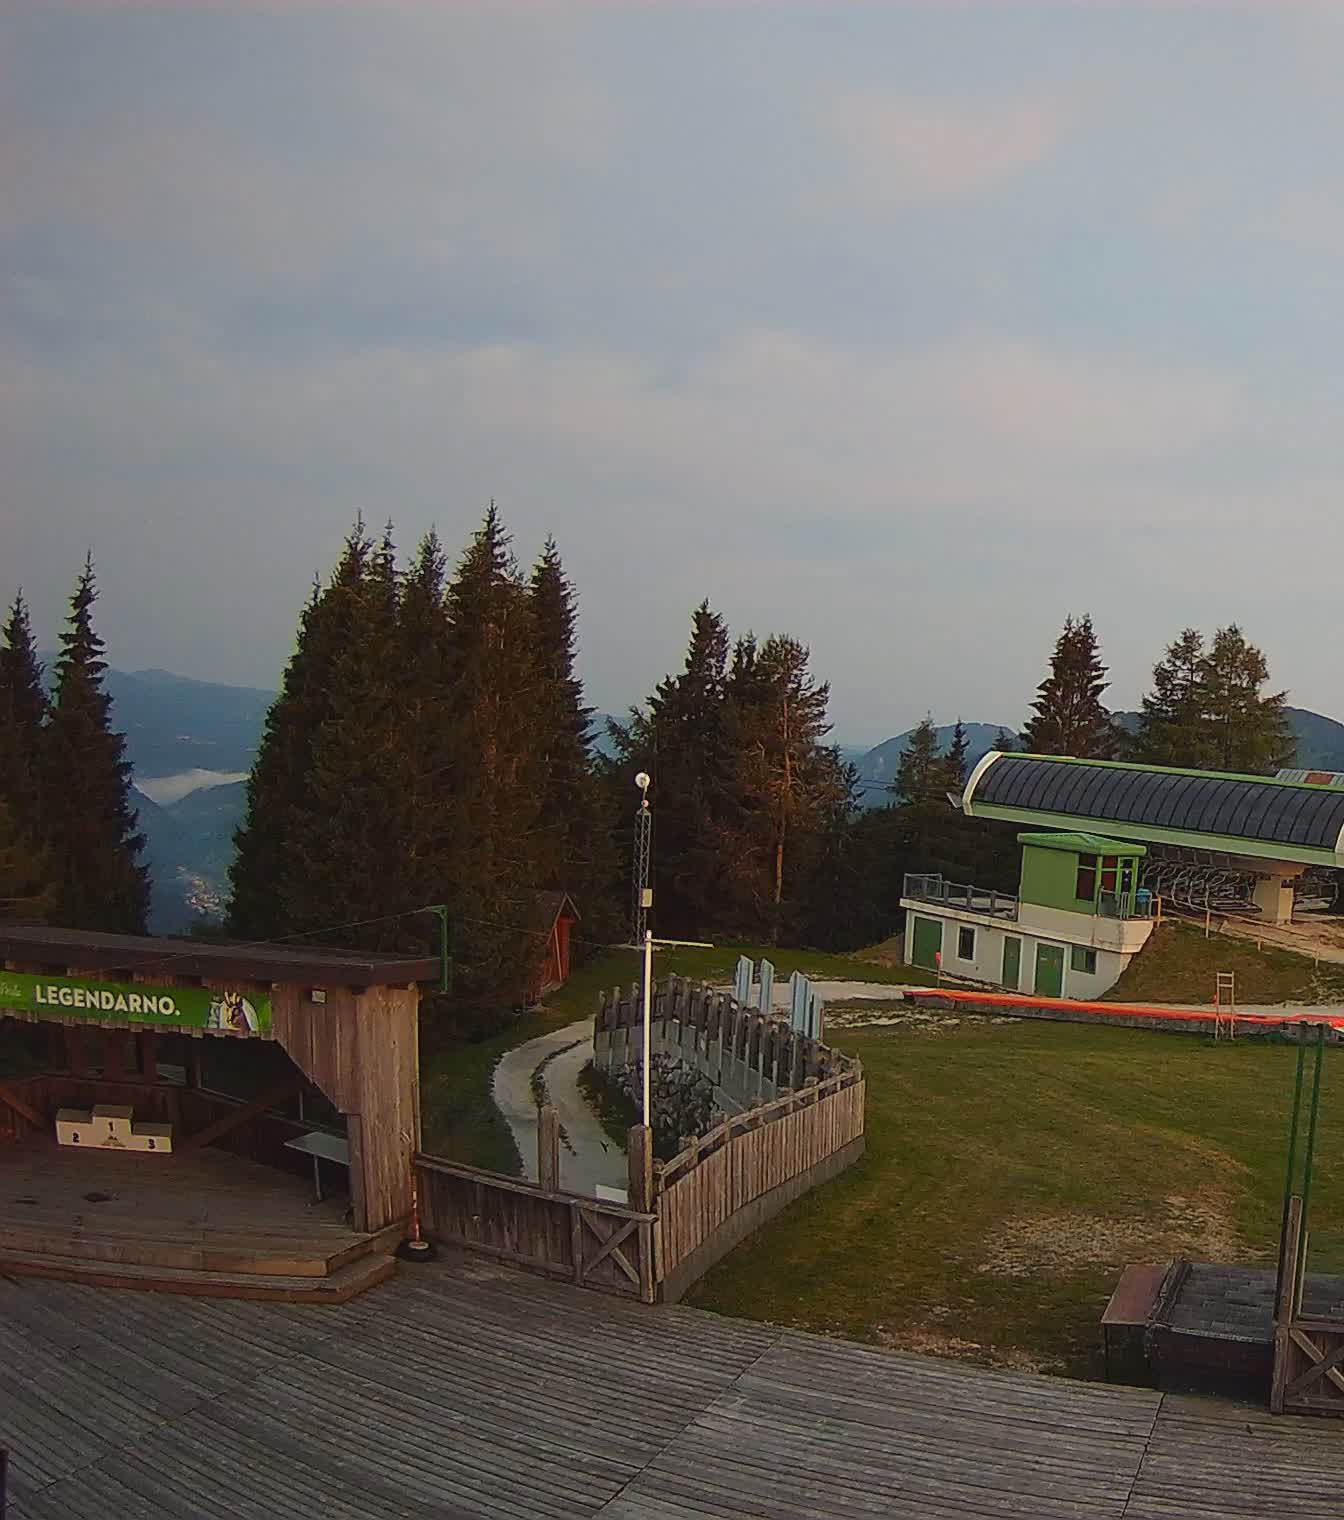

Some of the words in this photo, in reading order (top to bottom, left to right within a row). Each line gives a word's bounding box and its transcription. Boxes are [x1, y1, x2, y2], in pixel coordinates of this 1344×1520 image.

[35, 984, 182, 1017] LEGENDARNO.
[72, 1132, 80, 1143] 2
[148, 1138, 157, 1150] 3
